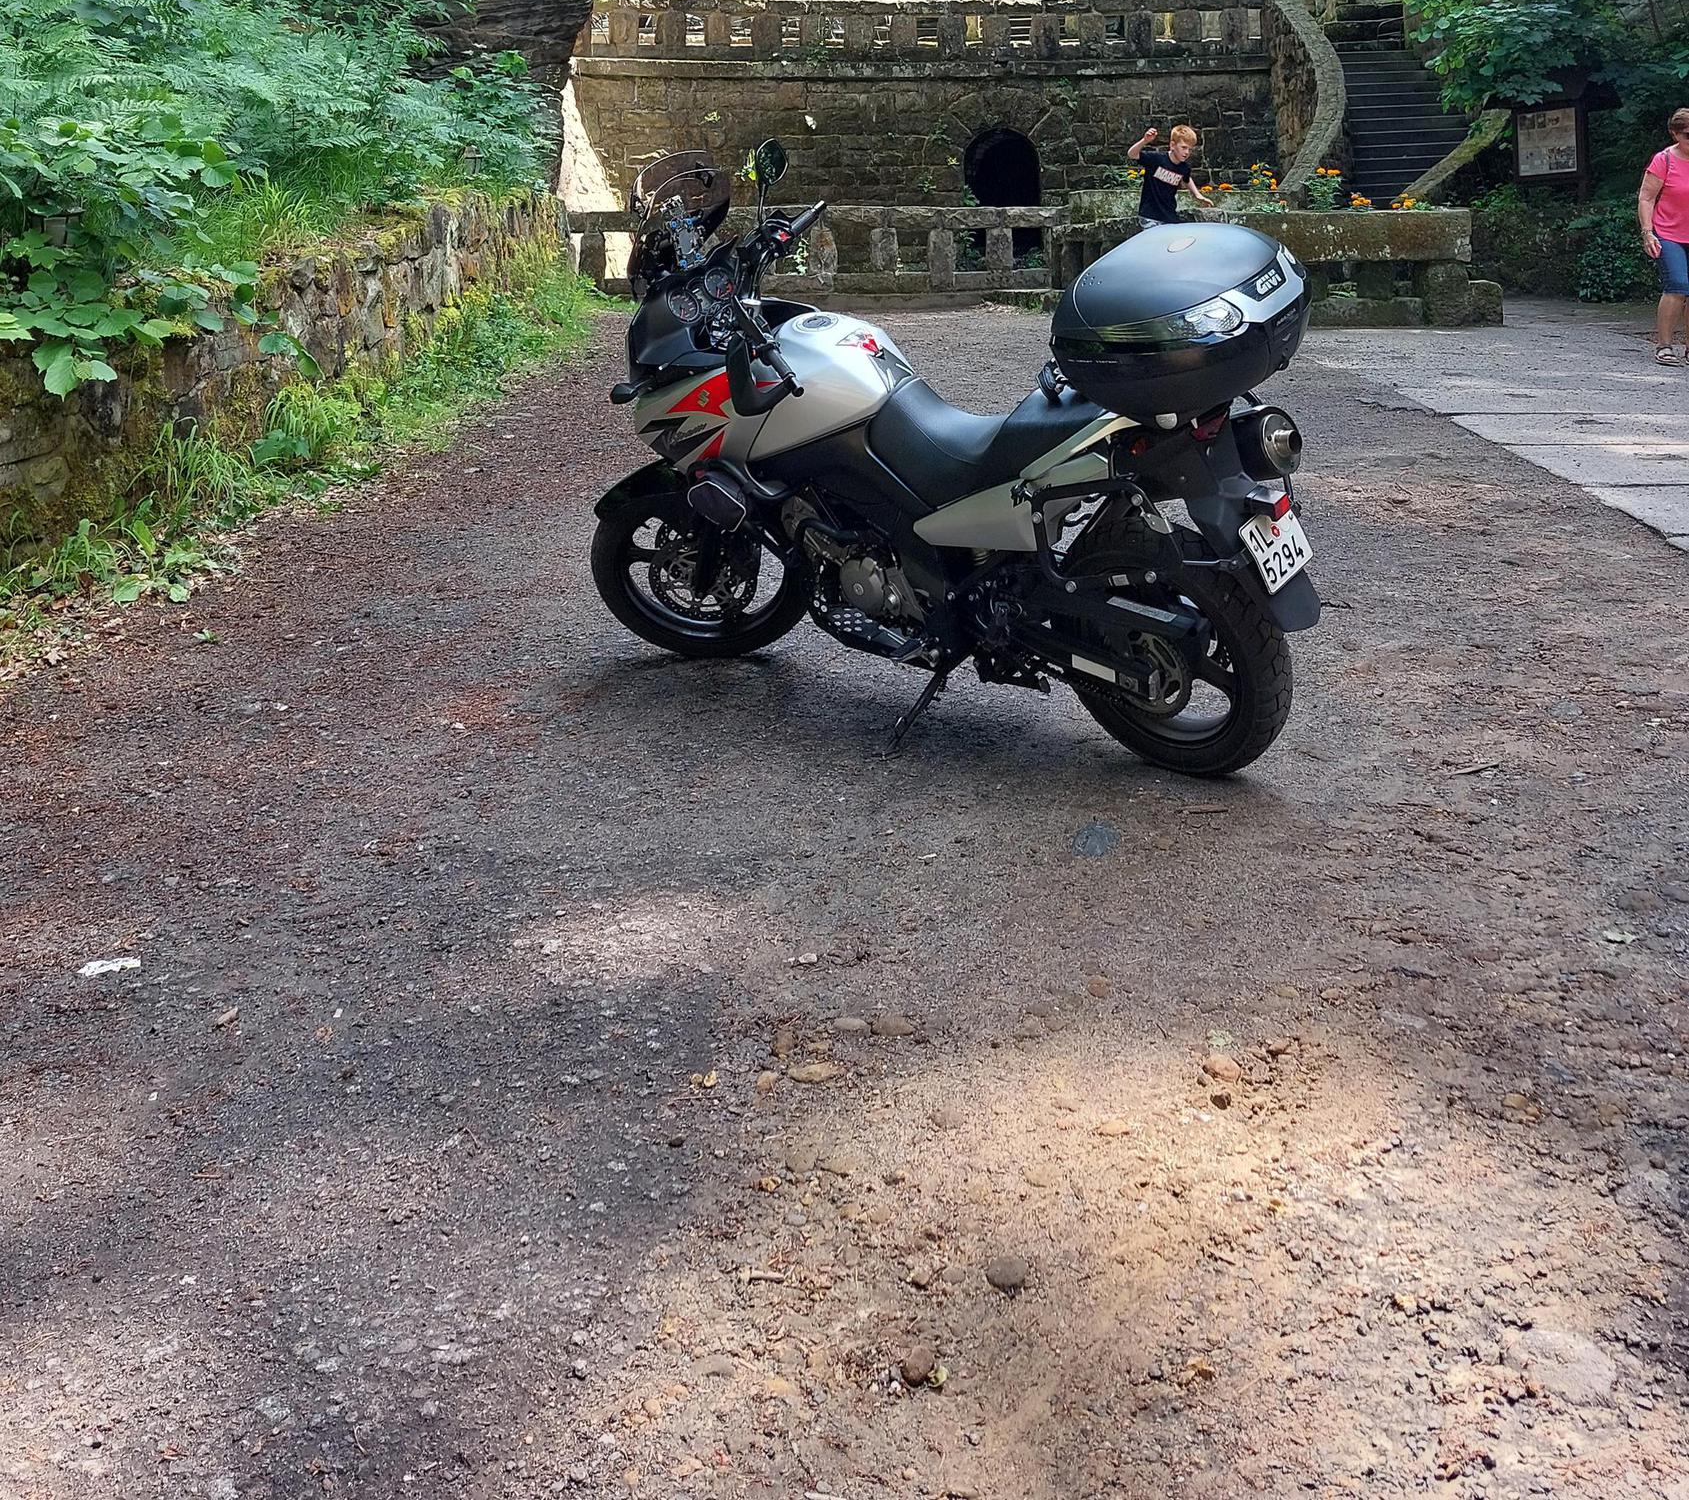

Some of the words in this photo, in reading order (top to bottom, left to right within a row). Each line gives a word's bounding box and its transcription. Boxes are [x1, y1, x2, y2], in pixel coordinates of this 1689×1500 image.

[1256, 269, 1281, 294] GIVI
[1249, 525, 1274, 553] 1L
[1262, 535, 1304, 584] 5294
